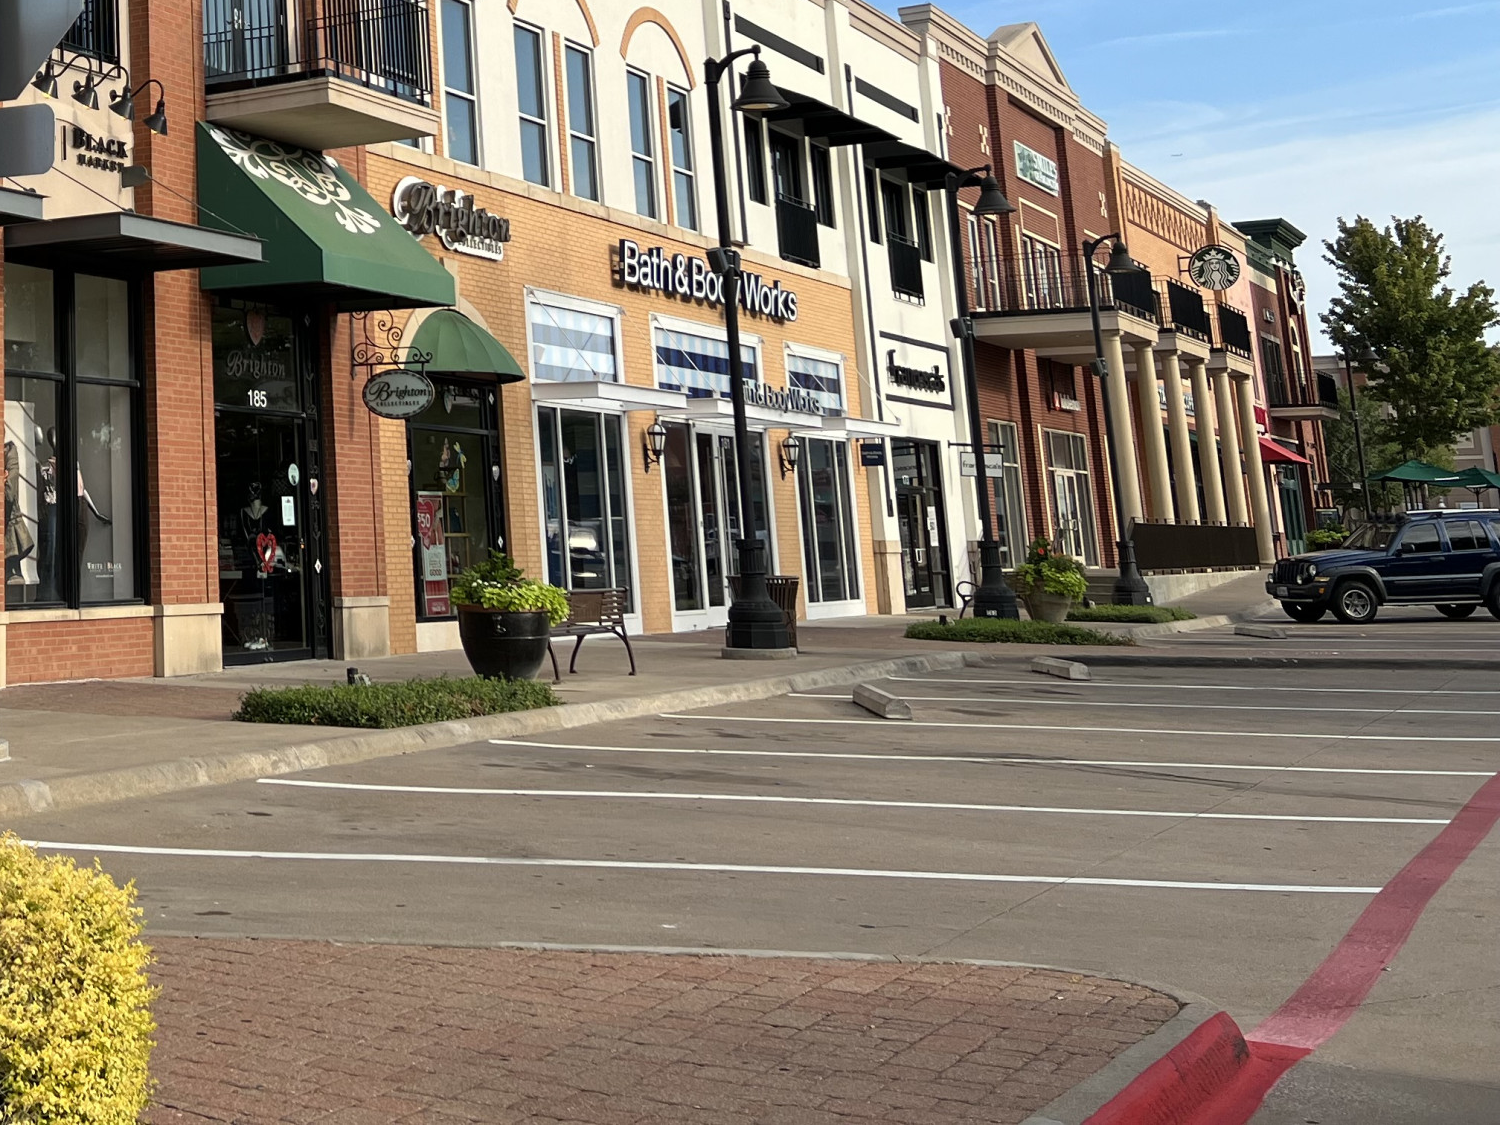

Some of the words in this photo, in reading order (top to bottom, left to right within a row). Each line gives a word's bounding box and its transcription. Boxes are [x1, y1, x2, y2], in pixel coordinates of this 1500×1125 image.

[73, 126, 129, 159] BLACK
[399, 179, 513, 244] Brighton
[619, 238, 673, 292] Bath
[672, 252, 691, 297] &
[741, 271, 798, 321] Works
[226, 349, 286, 379] Brighton
[247, 389, 268, 408] 185
[368, 381, 427, 402] Brighton
